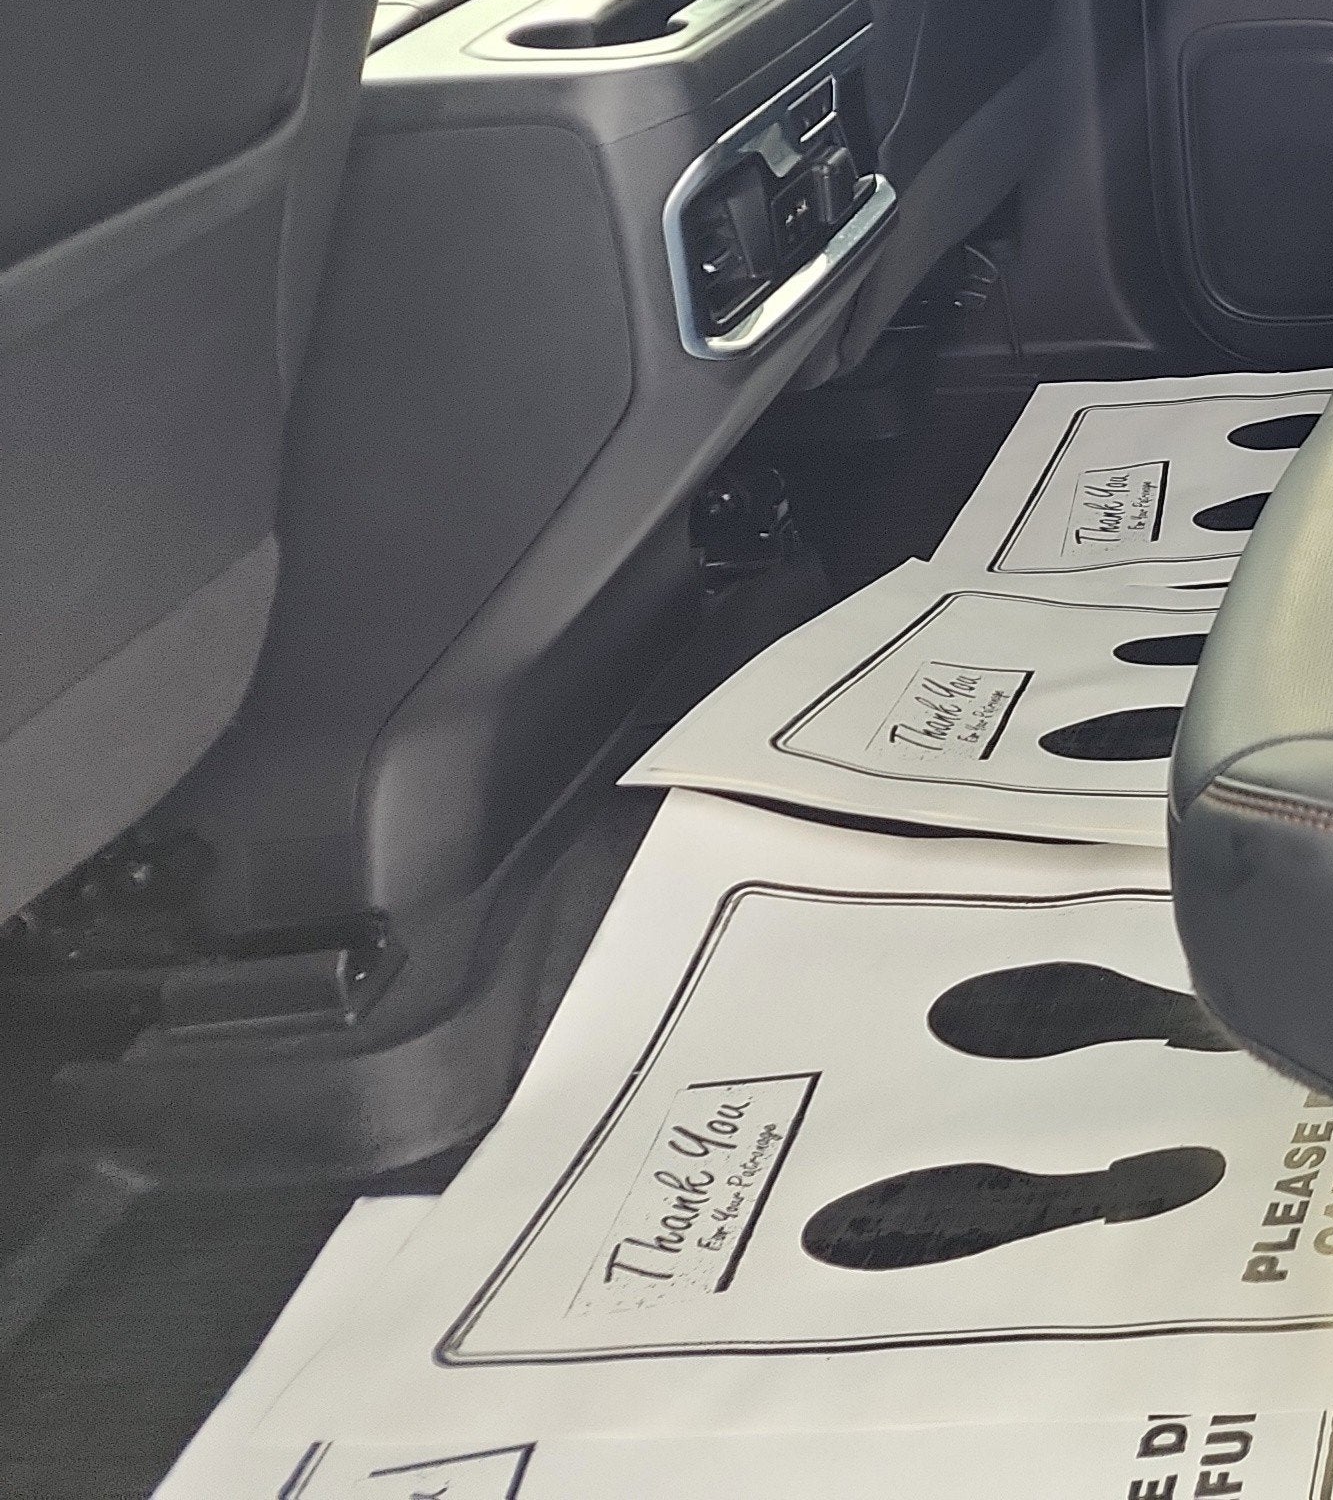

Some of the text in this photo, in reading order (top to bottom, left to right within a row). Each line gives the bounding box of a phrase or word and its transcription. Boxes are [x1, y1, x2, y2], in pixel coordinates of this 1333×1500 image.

[1075, 475, 1130, 544] Thank You
[889, 676, 981, 750] Thank You
[604, 1101, 751, 1283] Thank You
